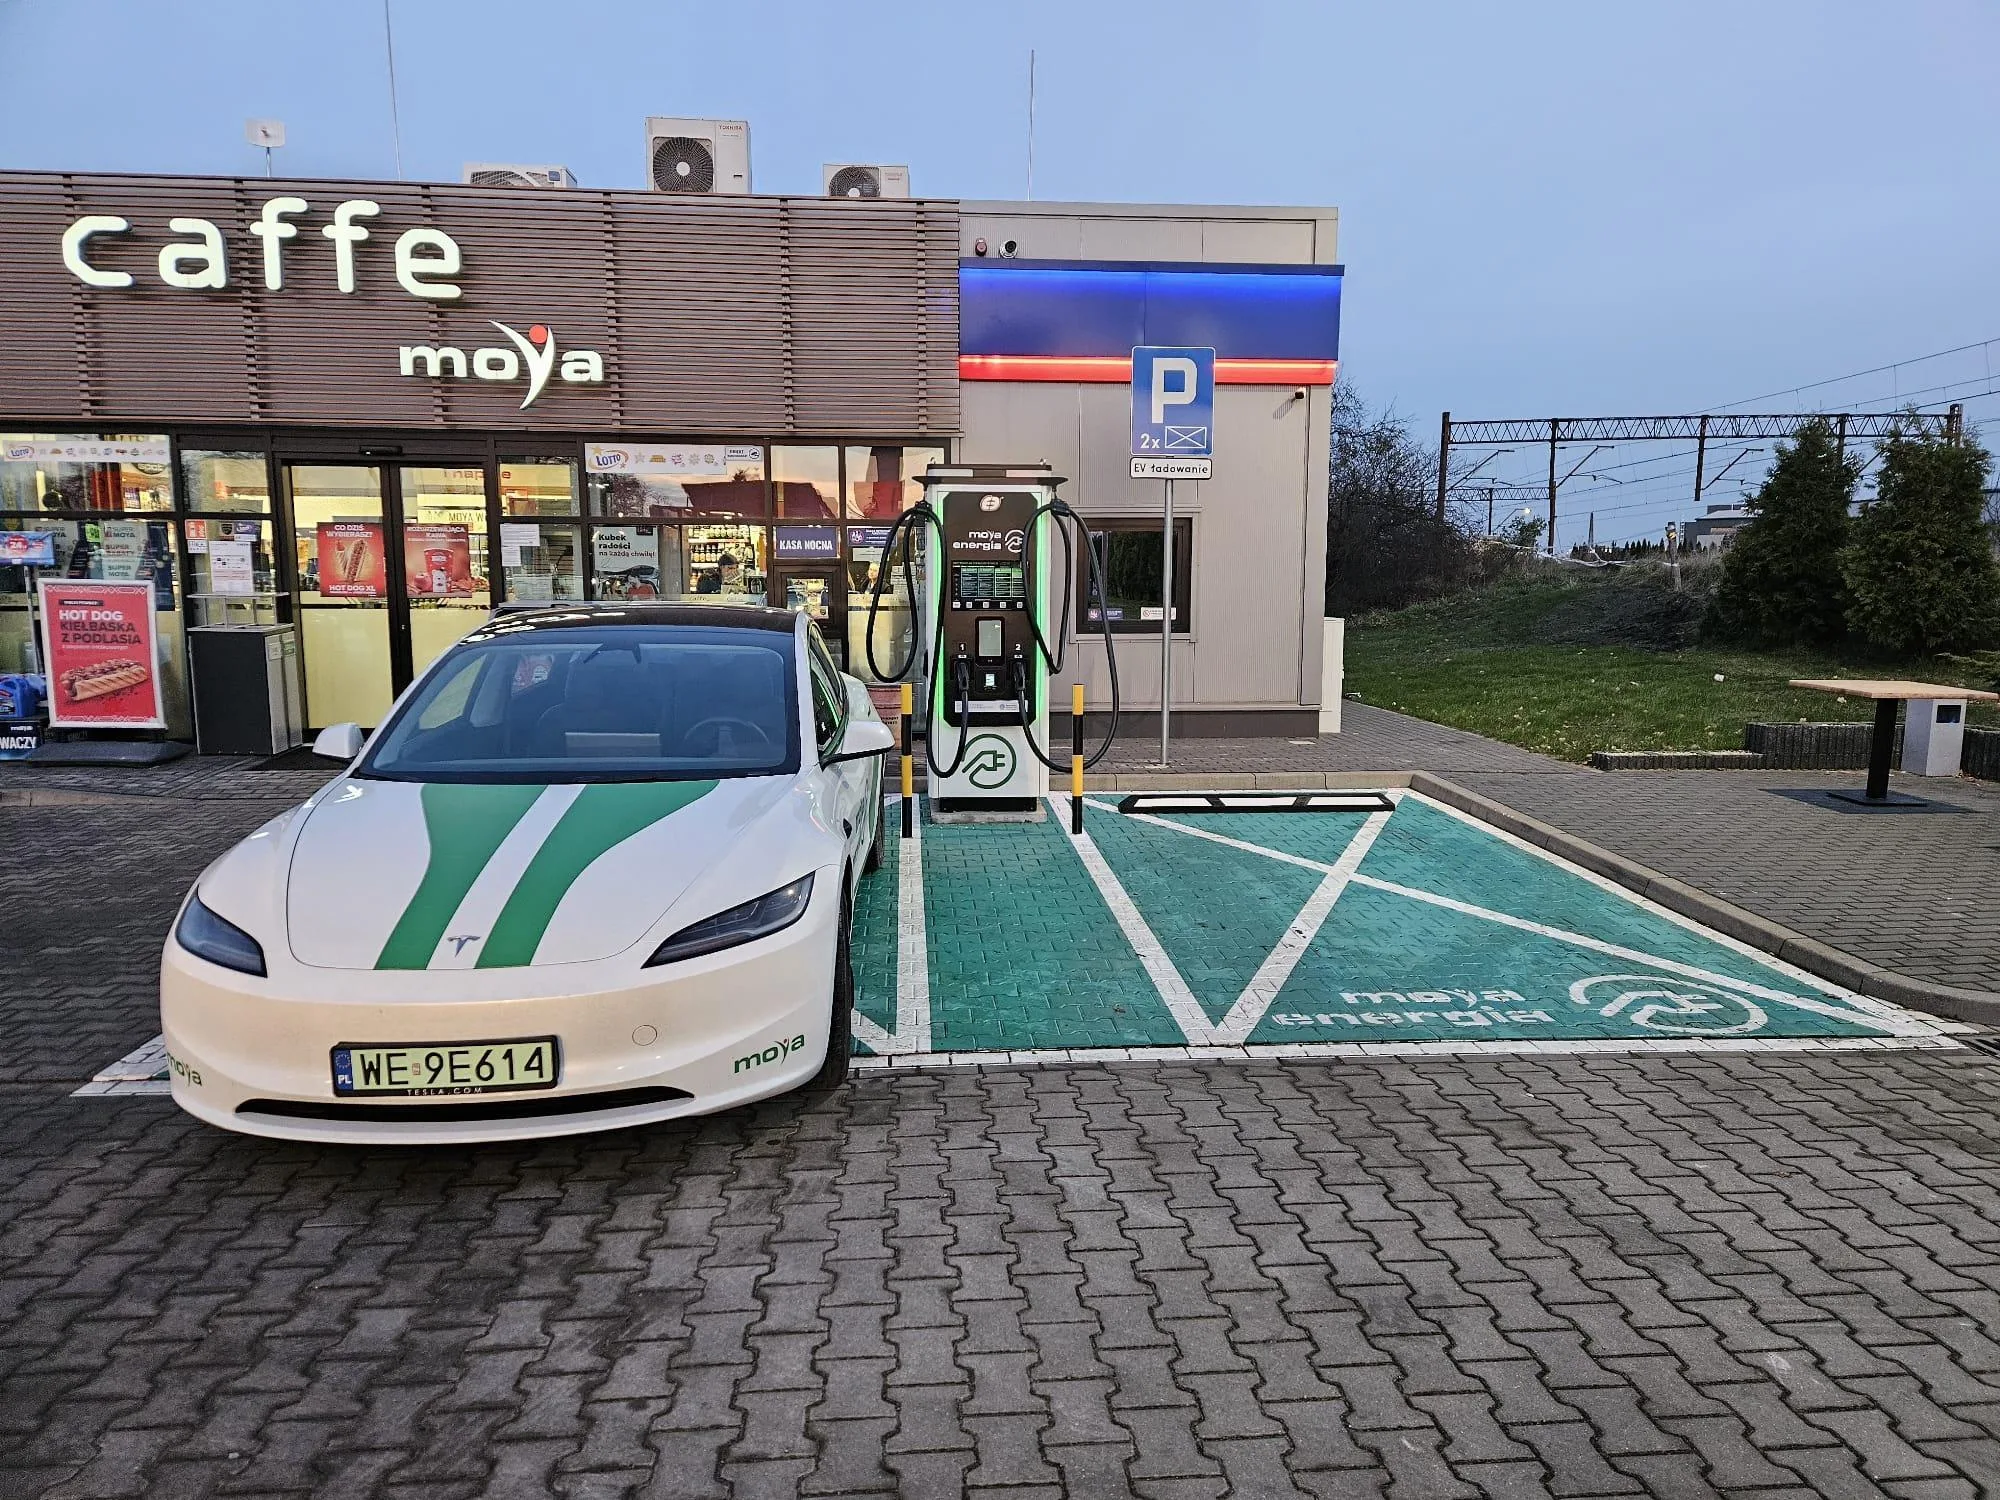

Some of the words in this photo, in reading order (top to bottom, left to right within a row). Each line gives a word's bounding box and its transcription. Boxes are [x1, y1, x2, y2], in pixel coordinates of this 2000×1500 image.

[61, 196, 463, 299] caffe
[399, 319, 604, 410] moya
[1151, 357, 1198, 424] P
[1140, 433, 1161, 449] 2x
[596, 453, 621, 467] LOTTO
[1134, 463, 1147, 473] EV
[1151, 463, 1208, 474] ładowanie
[968, 530, 1002, 542] moya
[598, 542, 631, 550] radości
[780, 540, 802, 550] KASA
[805, 540, 833, 551] NOCNA
[952, 541, 1002, 551] energia
[59, 609, 88, 621] HOT
[91, 610, 124, 621] DOG
[60, 621, 136, 633] KIEŁBASKA
[61, 633, 70, 643] Z
[73, 633, 142, 645] PODLASIA
[1015, 643, 1021, 651] 2
[1339, 988, 1526, 1009] moya
[1271, 1005, 1556, 1027] energia
[734, 1033, 805, 1074] moya
[360, 1052, 409, 1086] WE
[424, 1046, 545, 1085] 9E614
[338, 1074, 353, 1085] PL
[407, 1087, 484, 1097] TESLA.COM
